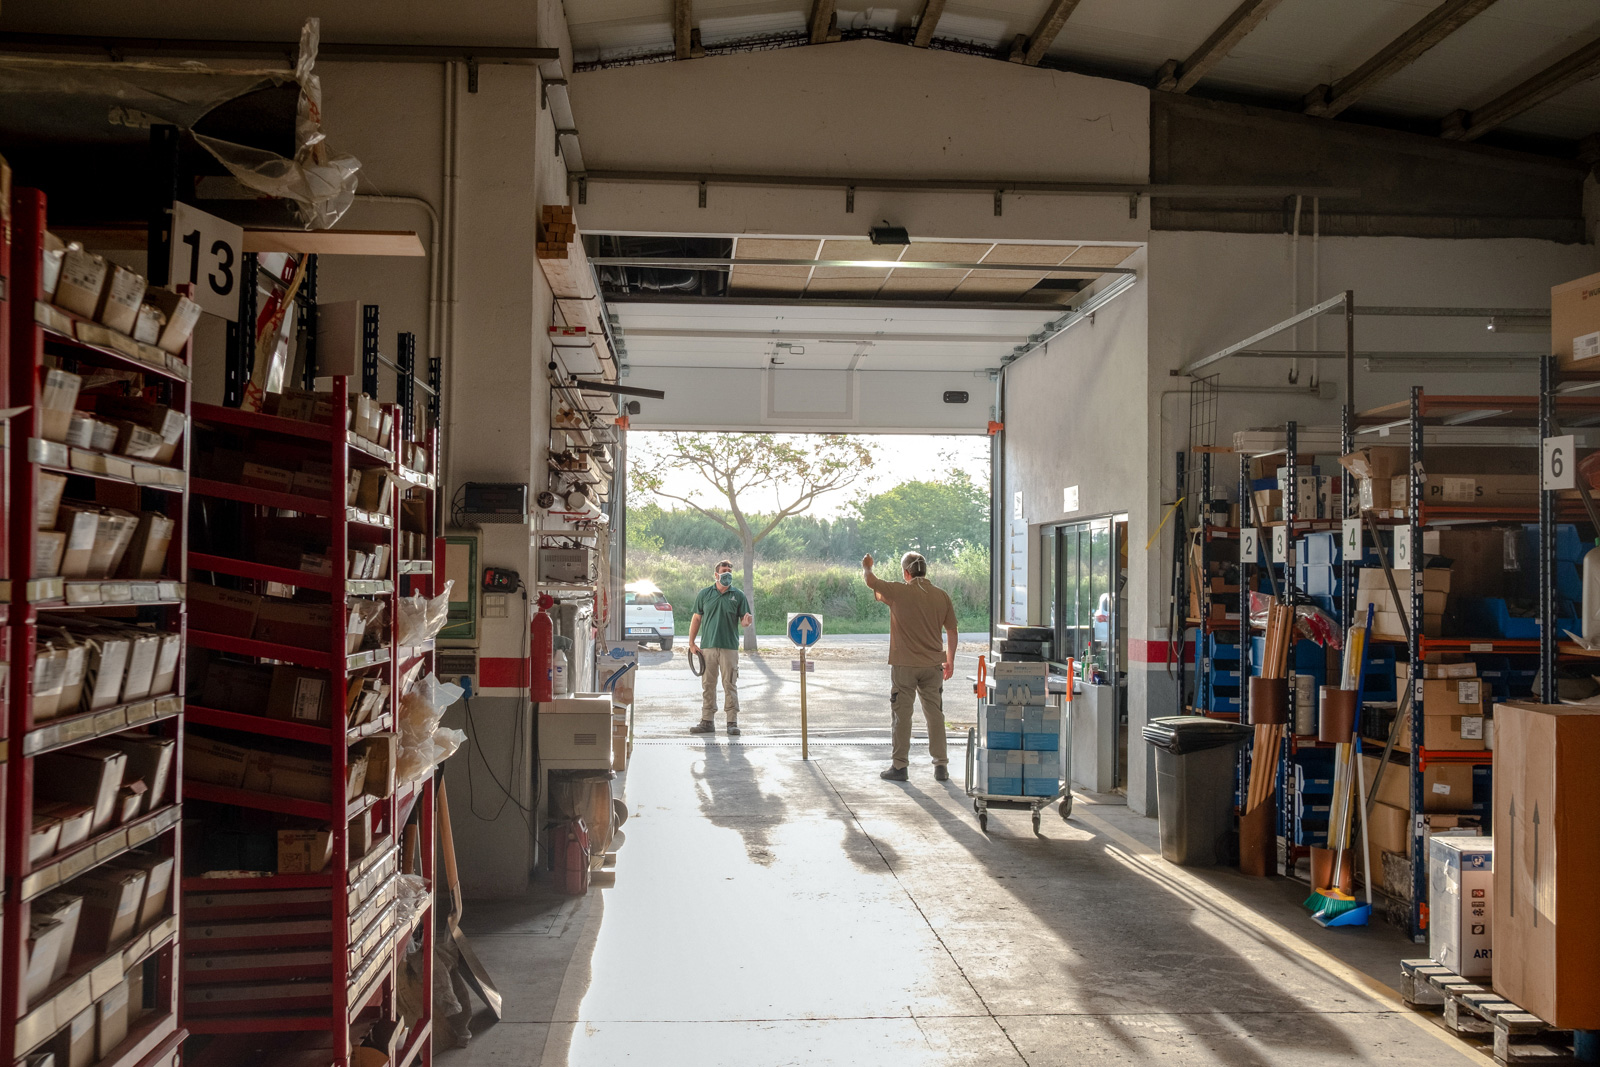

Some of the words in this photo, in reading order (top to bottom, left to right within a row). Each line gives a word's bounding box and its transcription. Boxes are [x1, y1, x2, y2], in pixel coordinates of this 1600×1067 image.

[183, 229, 234, 296] 13
[1552, 447, 1563, 478] 6
[1245, 536, 1252, 555] 2
[1276, 534, 1283, 555] 3
[1348, 527, 1357, 551] 4
[1399, 535, 1406, 560] 5
[1416, 579, 1423, 587] B
[1417, 821, 1423, 829] D
